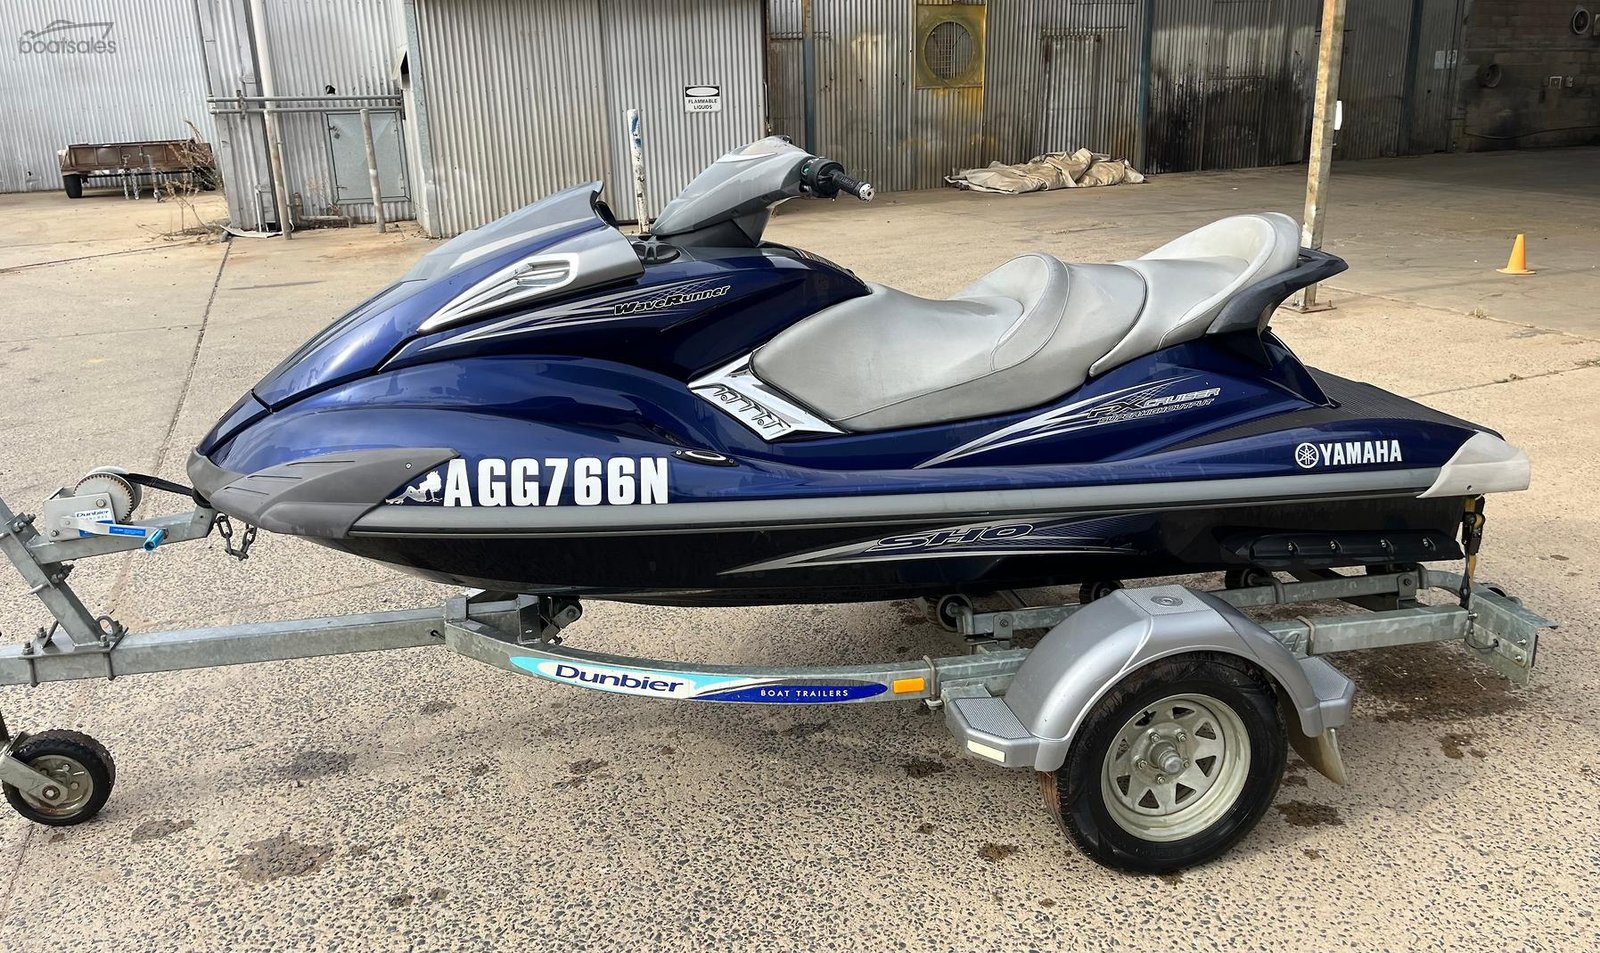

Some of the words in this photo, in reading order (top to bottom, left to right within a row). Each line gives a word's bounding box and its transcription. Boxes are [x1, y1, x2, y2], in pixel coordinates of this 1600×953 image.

[614, 285, 731, 316] WaveRunner
[1087, 400, 1145, 418] FX
[1143, 387, 1221, 408] CRUISER
[1319, 440, 1402, 466] YAMAHA
[443, 457, 669, 507] AGG766N
[865, 523, 1034, 552] SHO
[555, 664, 684, 692] Dunbier
[796, 689, 849, 697] TRAILERS
